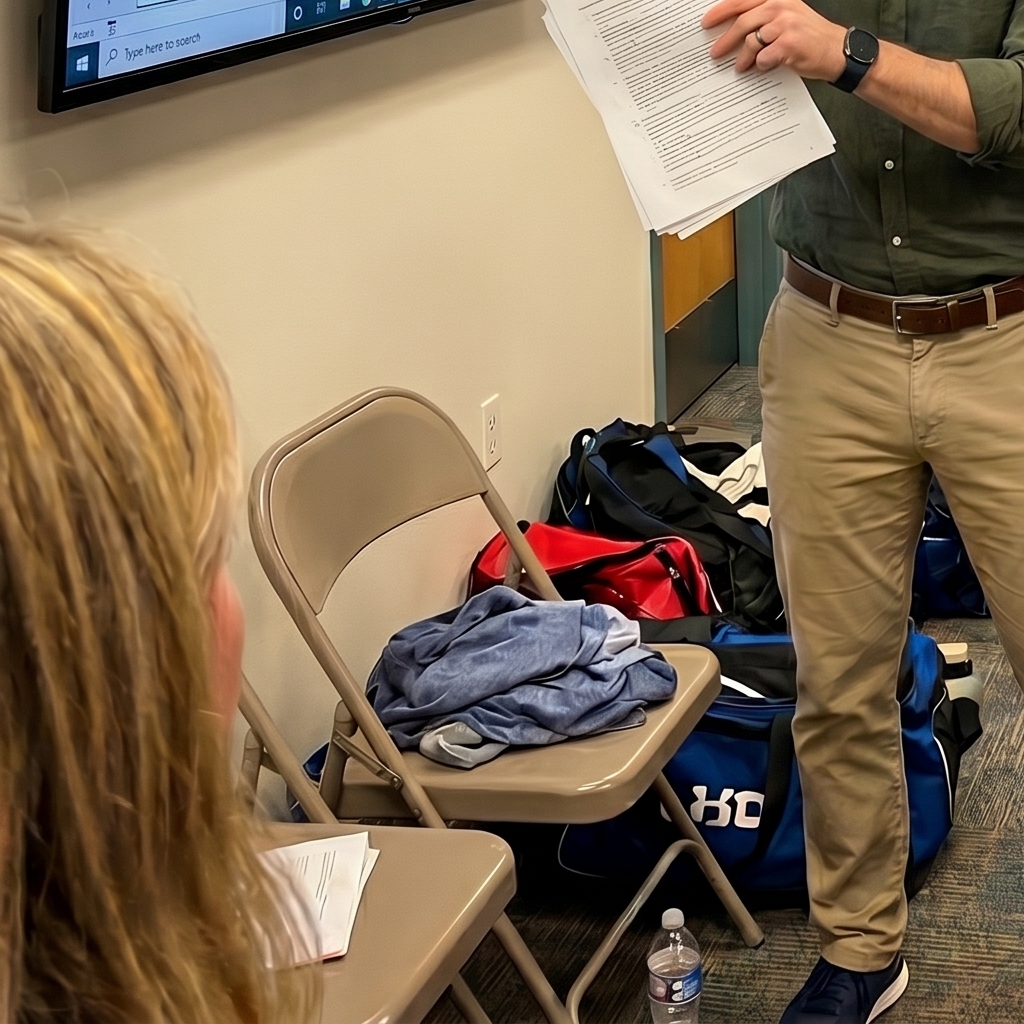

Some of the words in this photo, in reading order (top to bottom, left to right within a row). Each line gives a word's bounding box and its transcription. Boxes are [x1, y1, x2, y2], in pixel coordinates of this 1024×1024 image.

[125, 47, 144, 62] Type
[145, 43, 163, 55] here
[165, 40, 174, 51] to
